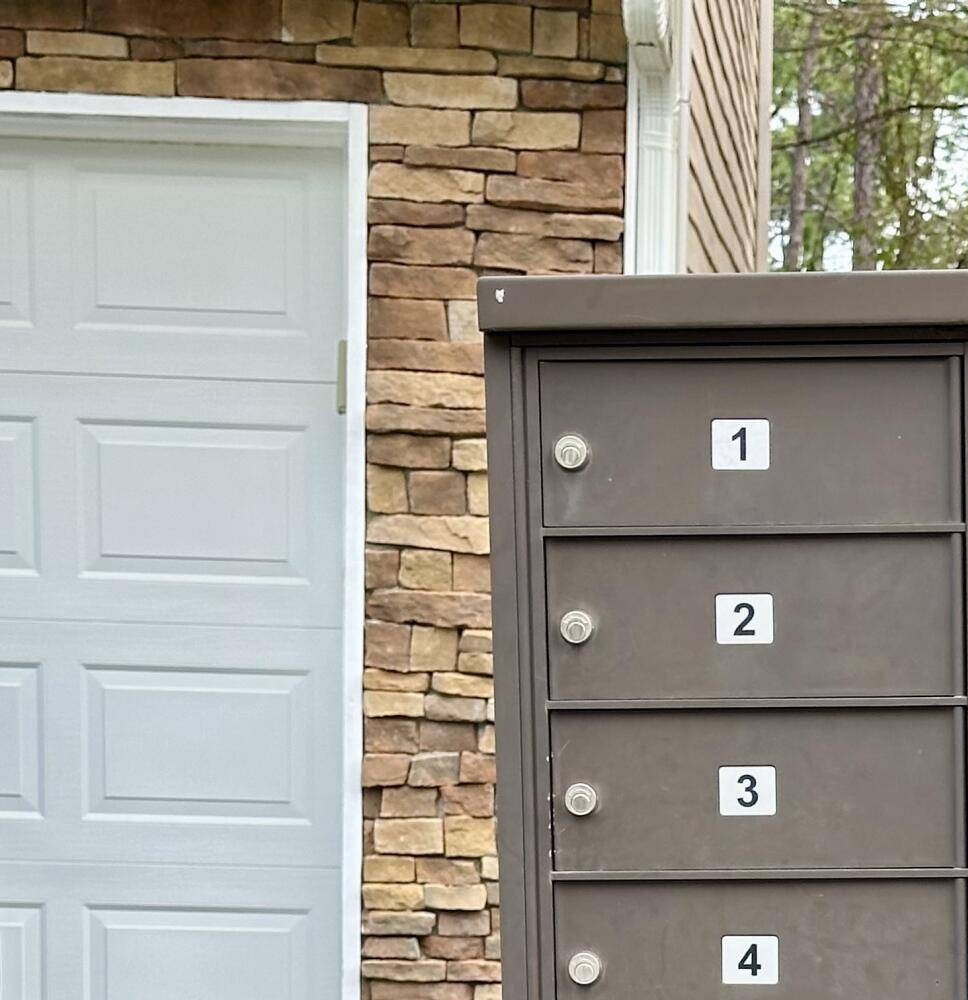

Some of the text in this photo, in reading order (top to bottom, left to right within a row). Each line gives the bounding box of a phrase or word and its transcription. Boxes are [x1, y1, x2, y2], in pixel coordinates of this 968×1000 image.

[731, 427, 747, 462] 1
[733, 602, 756, 636] 2
[737, 774, 759, 808] 3
[738, 943, 762, 977] 4
